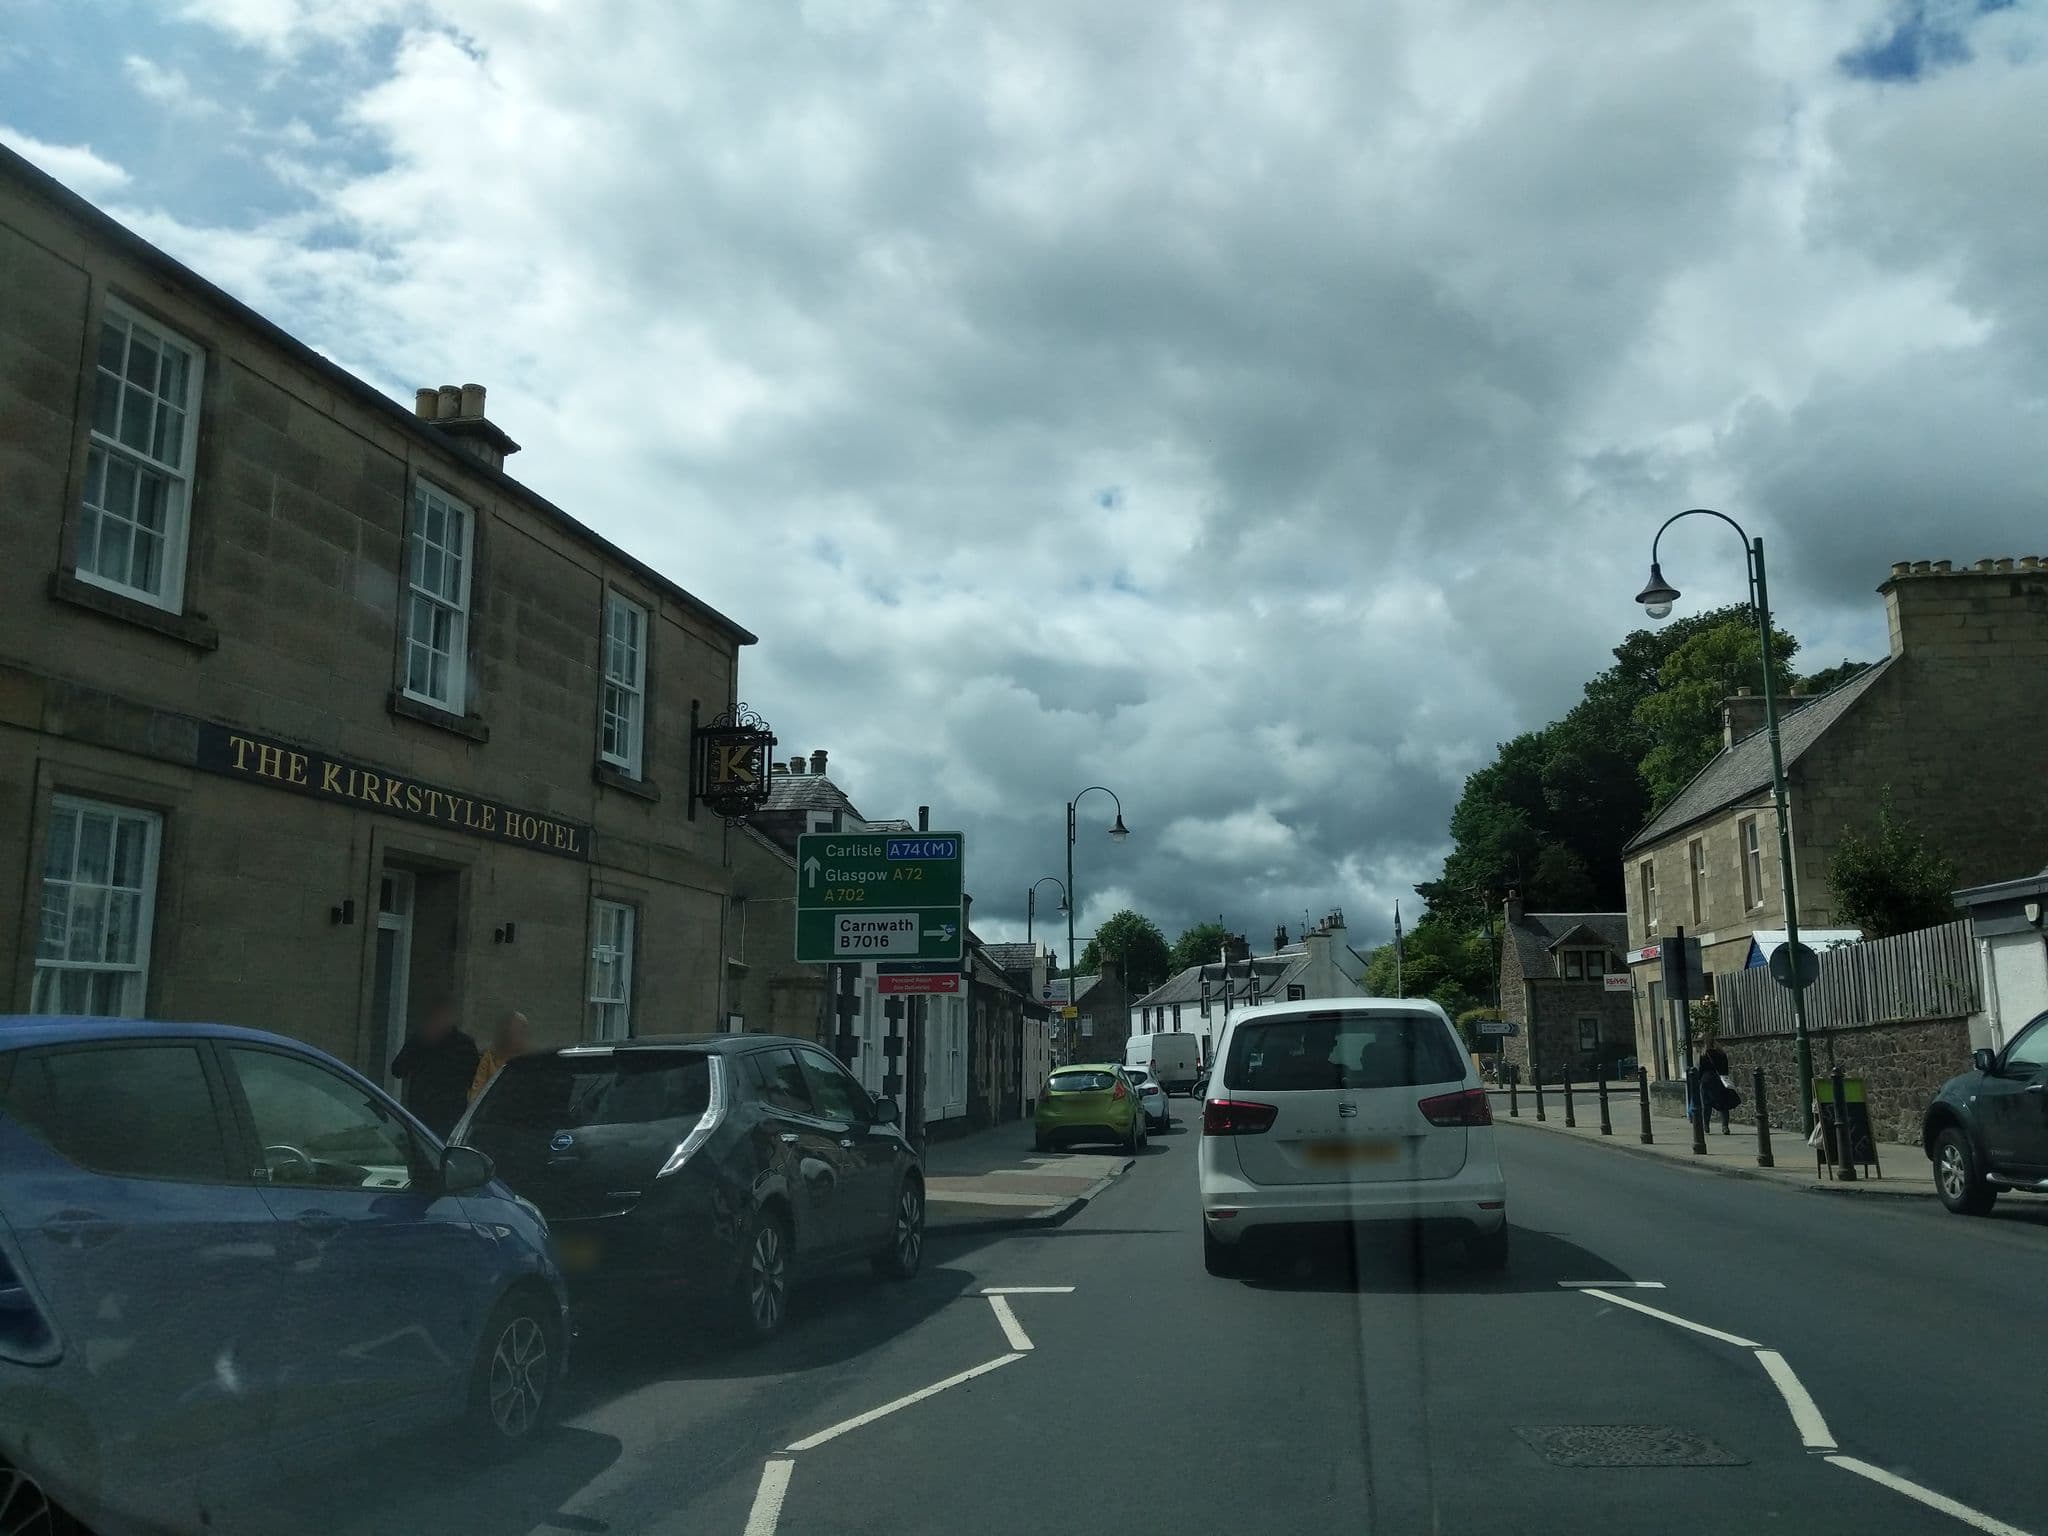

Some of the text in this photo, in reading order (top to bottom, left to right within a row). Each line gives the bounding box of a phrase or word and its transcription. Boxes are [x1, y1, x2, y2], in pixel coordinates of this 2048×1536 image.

[712, 745, 757, 784] K
[229, 735, 580, 854] THE KIRKSTYLE HOTEL
[826, 844, 881, 857] Carlisle
[825, 868, 923, 883] Glasgow A72
[824, 888, 864, 902] A702
[840, 919, 913, 932] Carnwath
[840, 935, 889, 948] B7016
